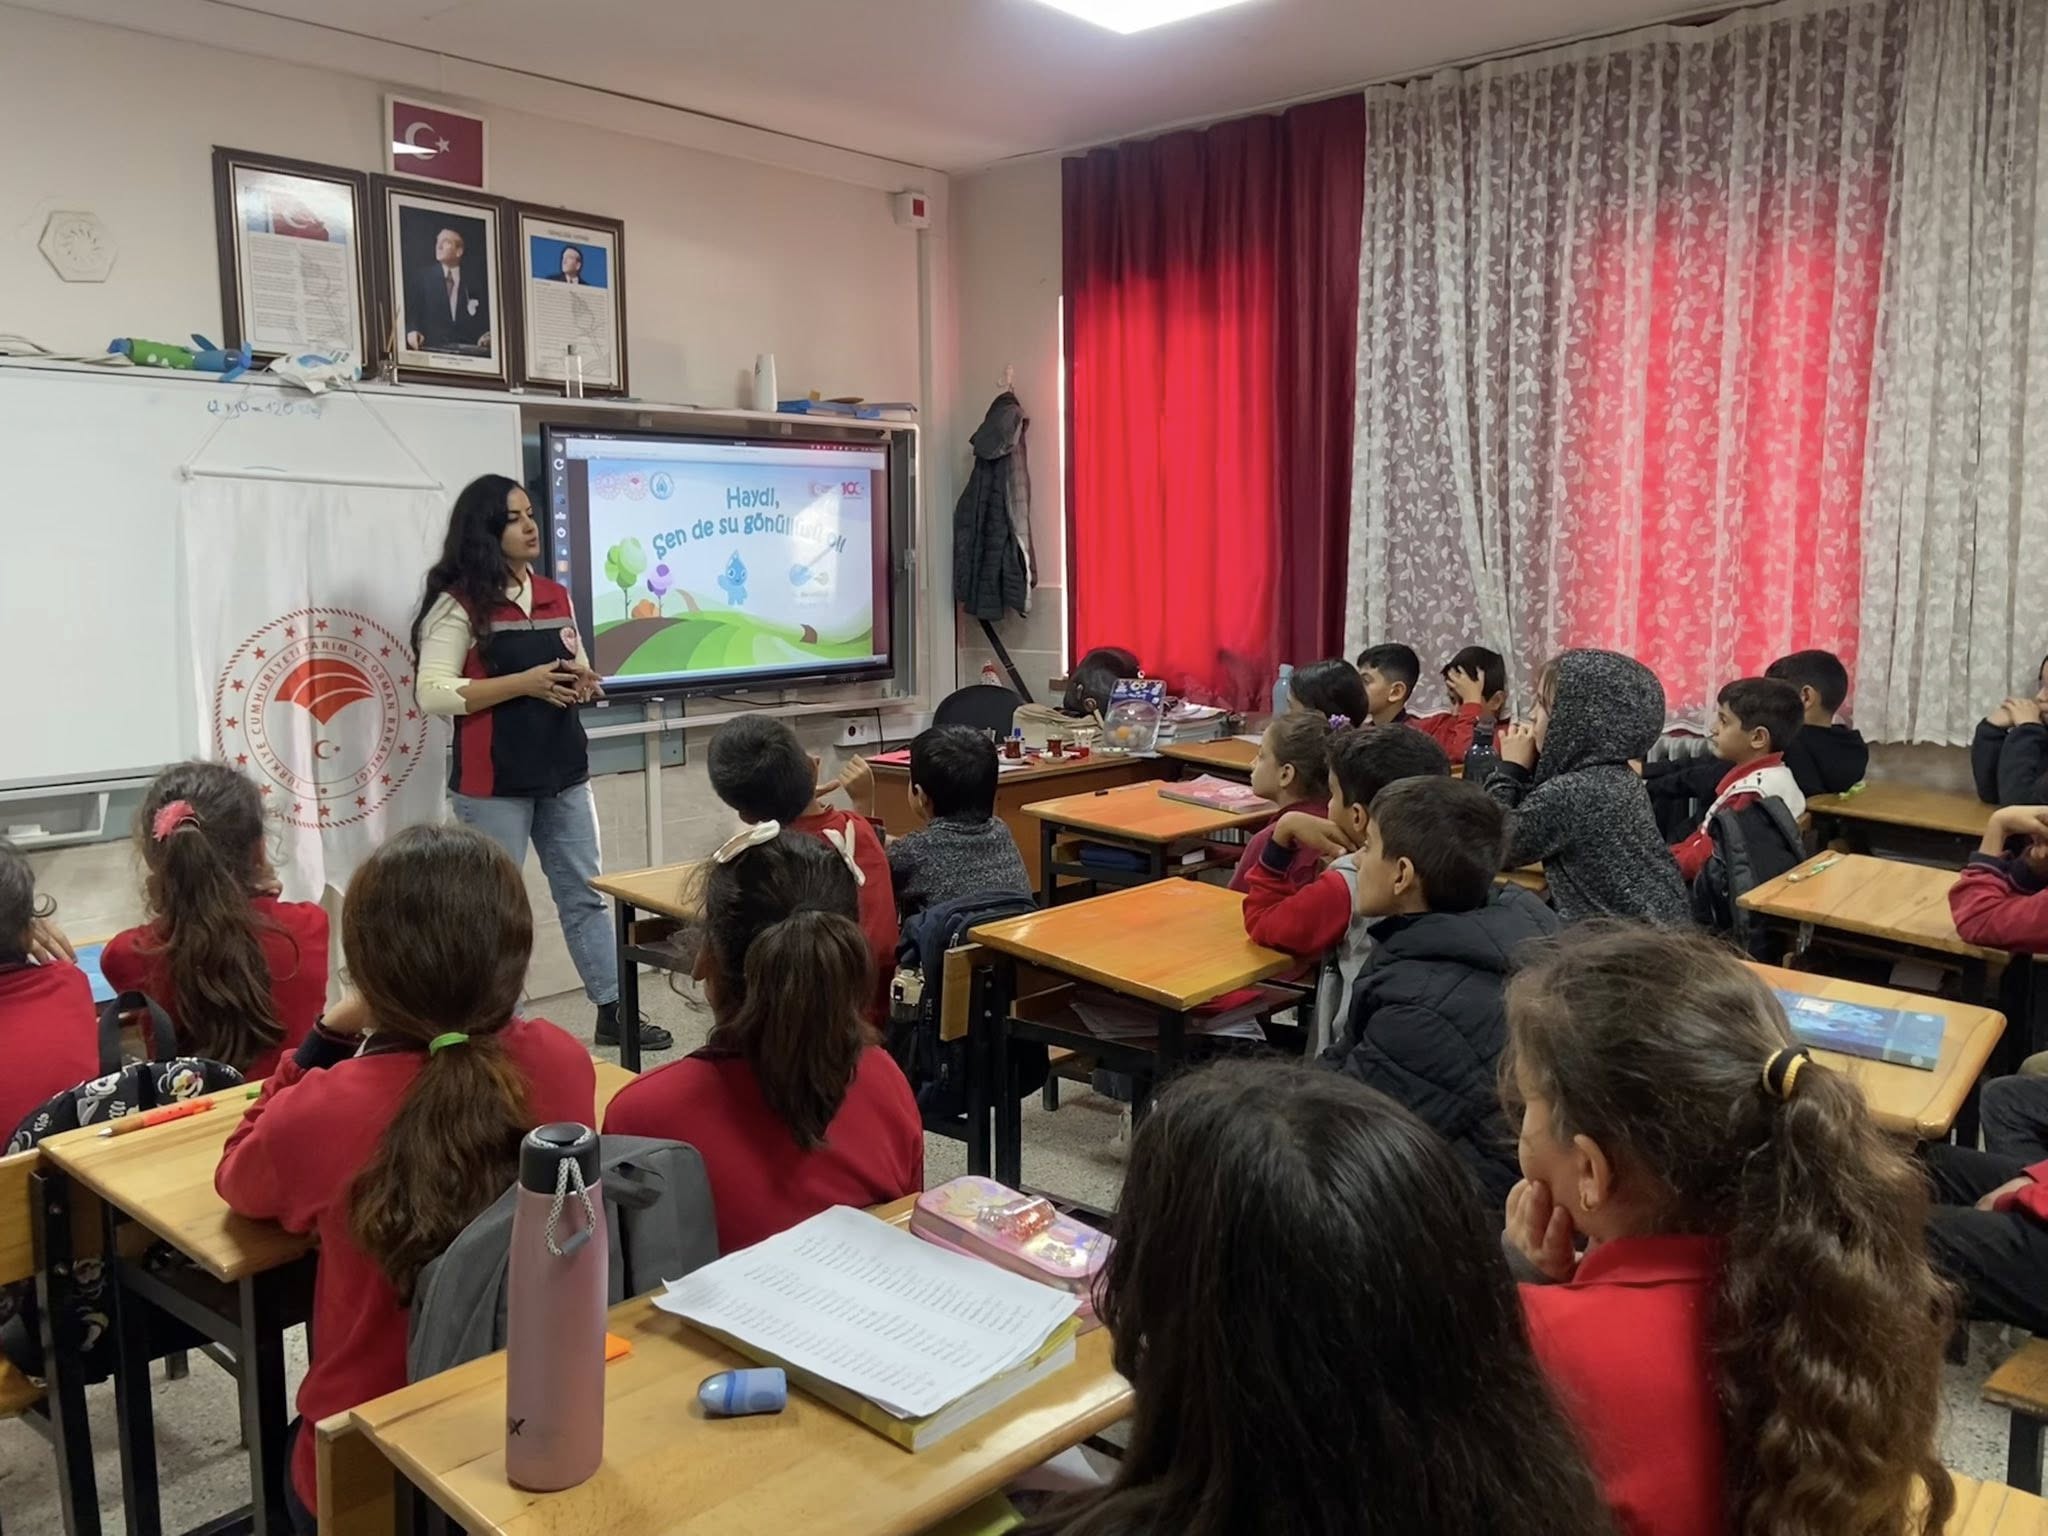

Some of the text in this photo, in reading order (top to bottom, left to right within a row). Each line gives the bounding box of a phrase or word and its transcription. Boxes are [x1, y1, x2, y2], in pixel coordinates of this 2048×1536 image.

[692, 519, 714, 541] de
[719, 517, 739, 536] su
[354, 650, 368, 664] VE
[371, 665, 395, 710] ORMAN
